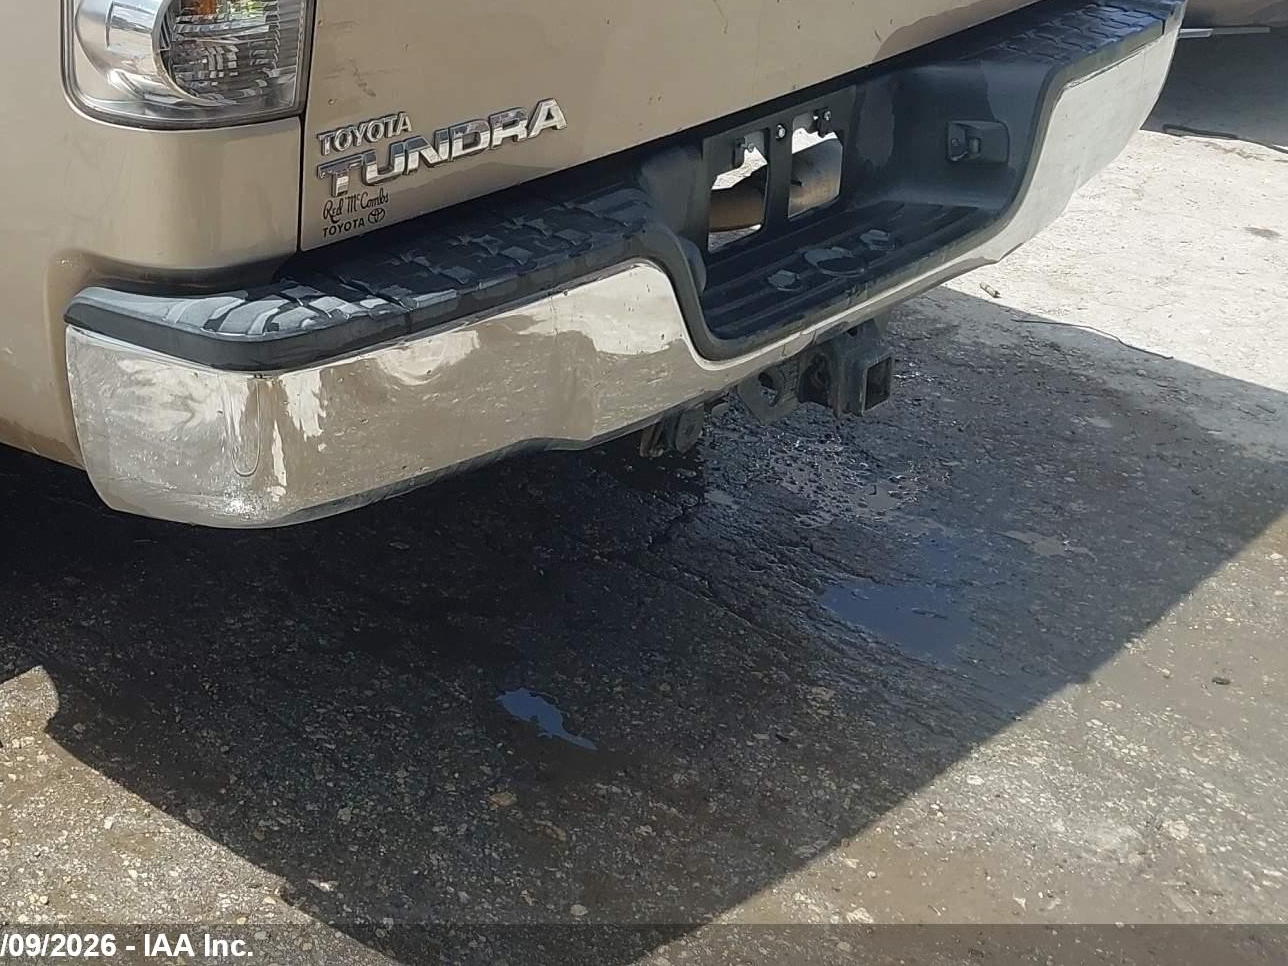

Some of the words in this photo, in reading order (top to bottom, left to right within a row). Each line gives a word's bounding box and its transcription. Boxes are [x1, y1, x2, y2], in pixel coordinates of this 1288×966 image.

[317, 111, 413, 156] TOYOTA
[317, 97, 568, 197] TUNDRA
[323, 197, 344, 224] Red
[345, 187, 389, 214] McCombs
[322, 217, 365, 238] TOYOTA
